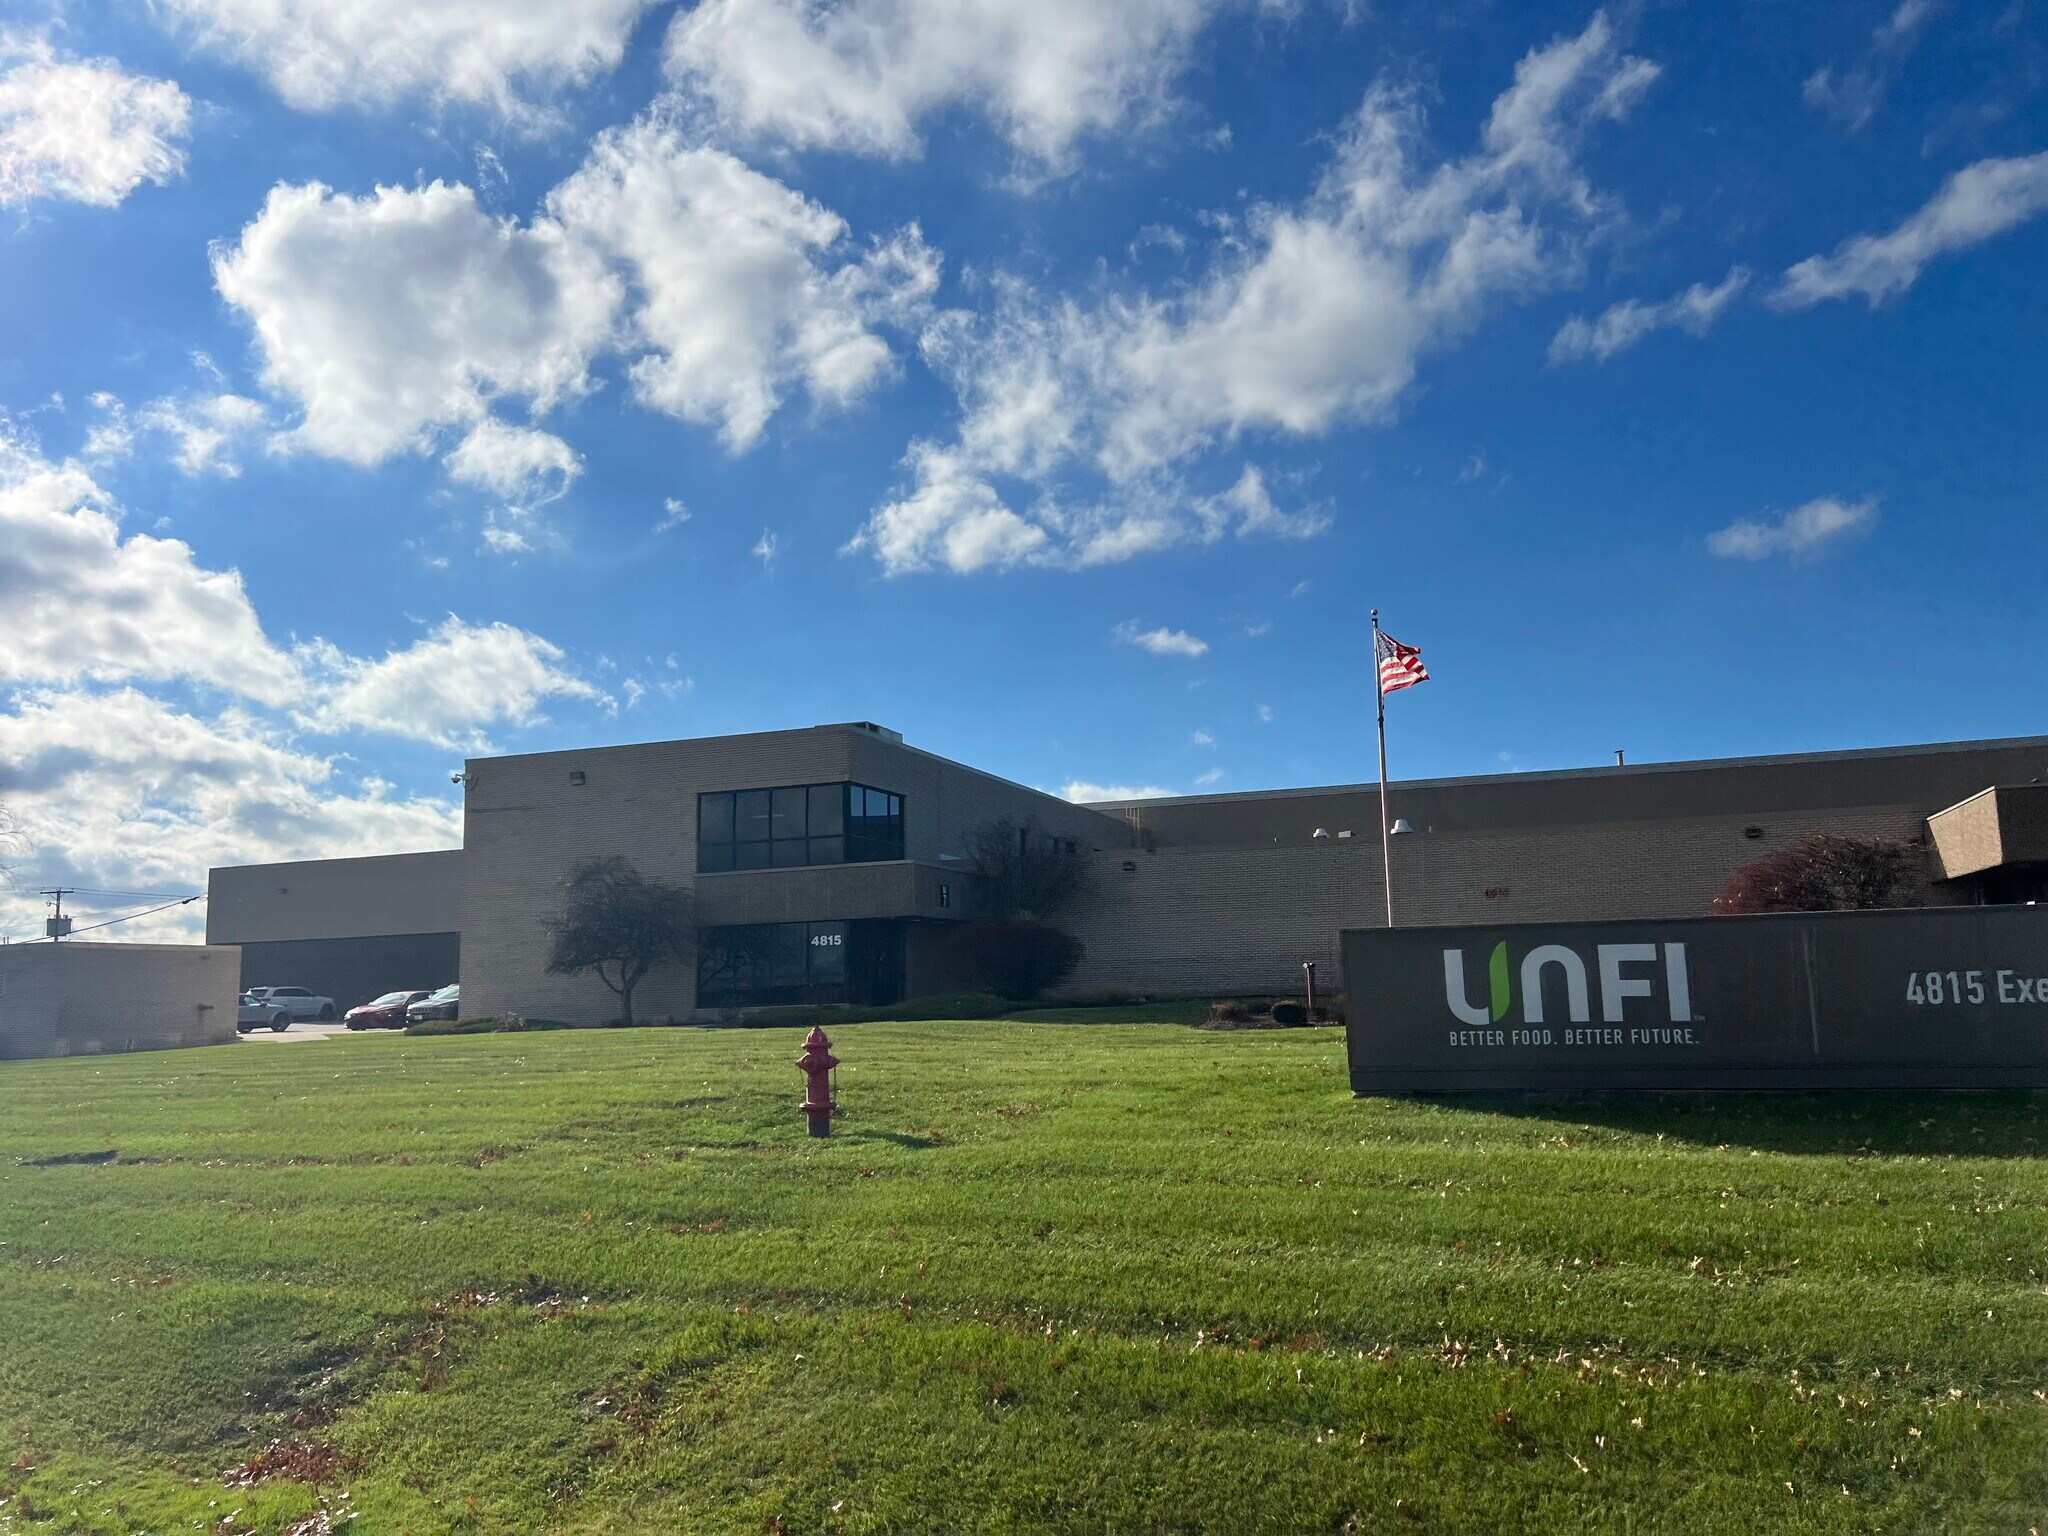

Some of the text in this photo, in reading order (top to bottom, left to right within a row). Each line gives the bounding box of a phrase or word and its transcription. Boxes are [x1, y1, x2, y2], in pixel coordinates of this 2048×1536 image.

[811, 934, 842, 946] 4815
[1443, 939, 1692, 1026] UNFI
[1906, 969, 2048, 1005] 4815 Exe
[1449, 1028, 1700, 1046] BETTER FOOD. BETTER FUTURE.
